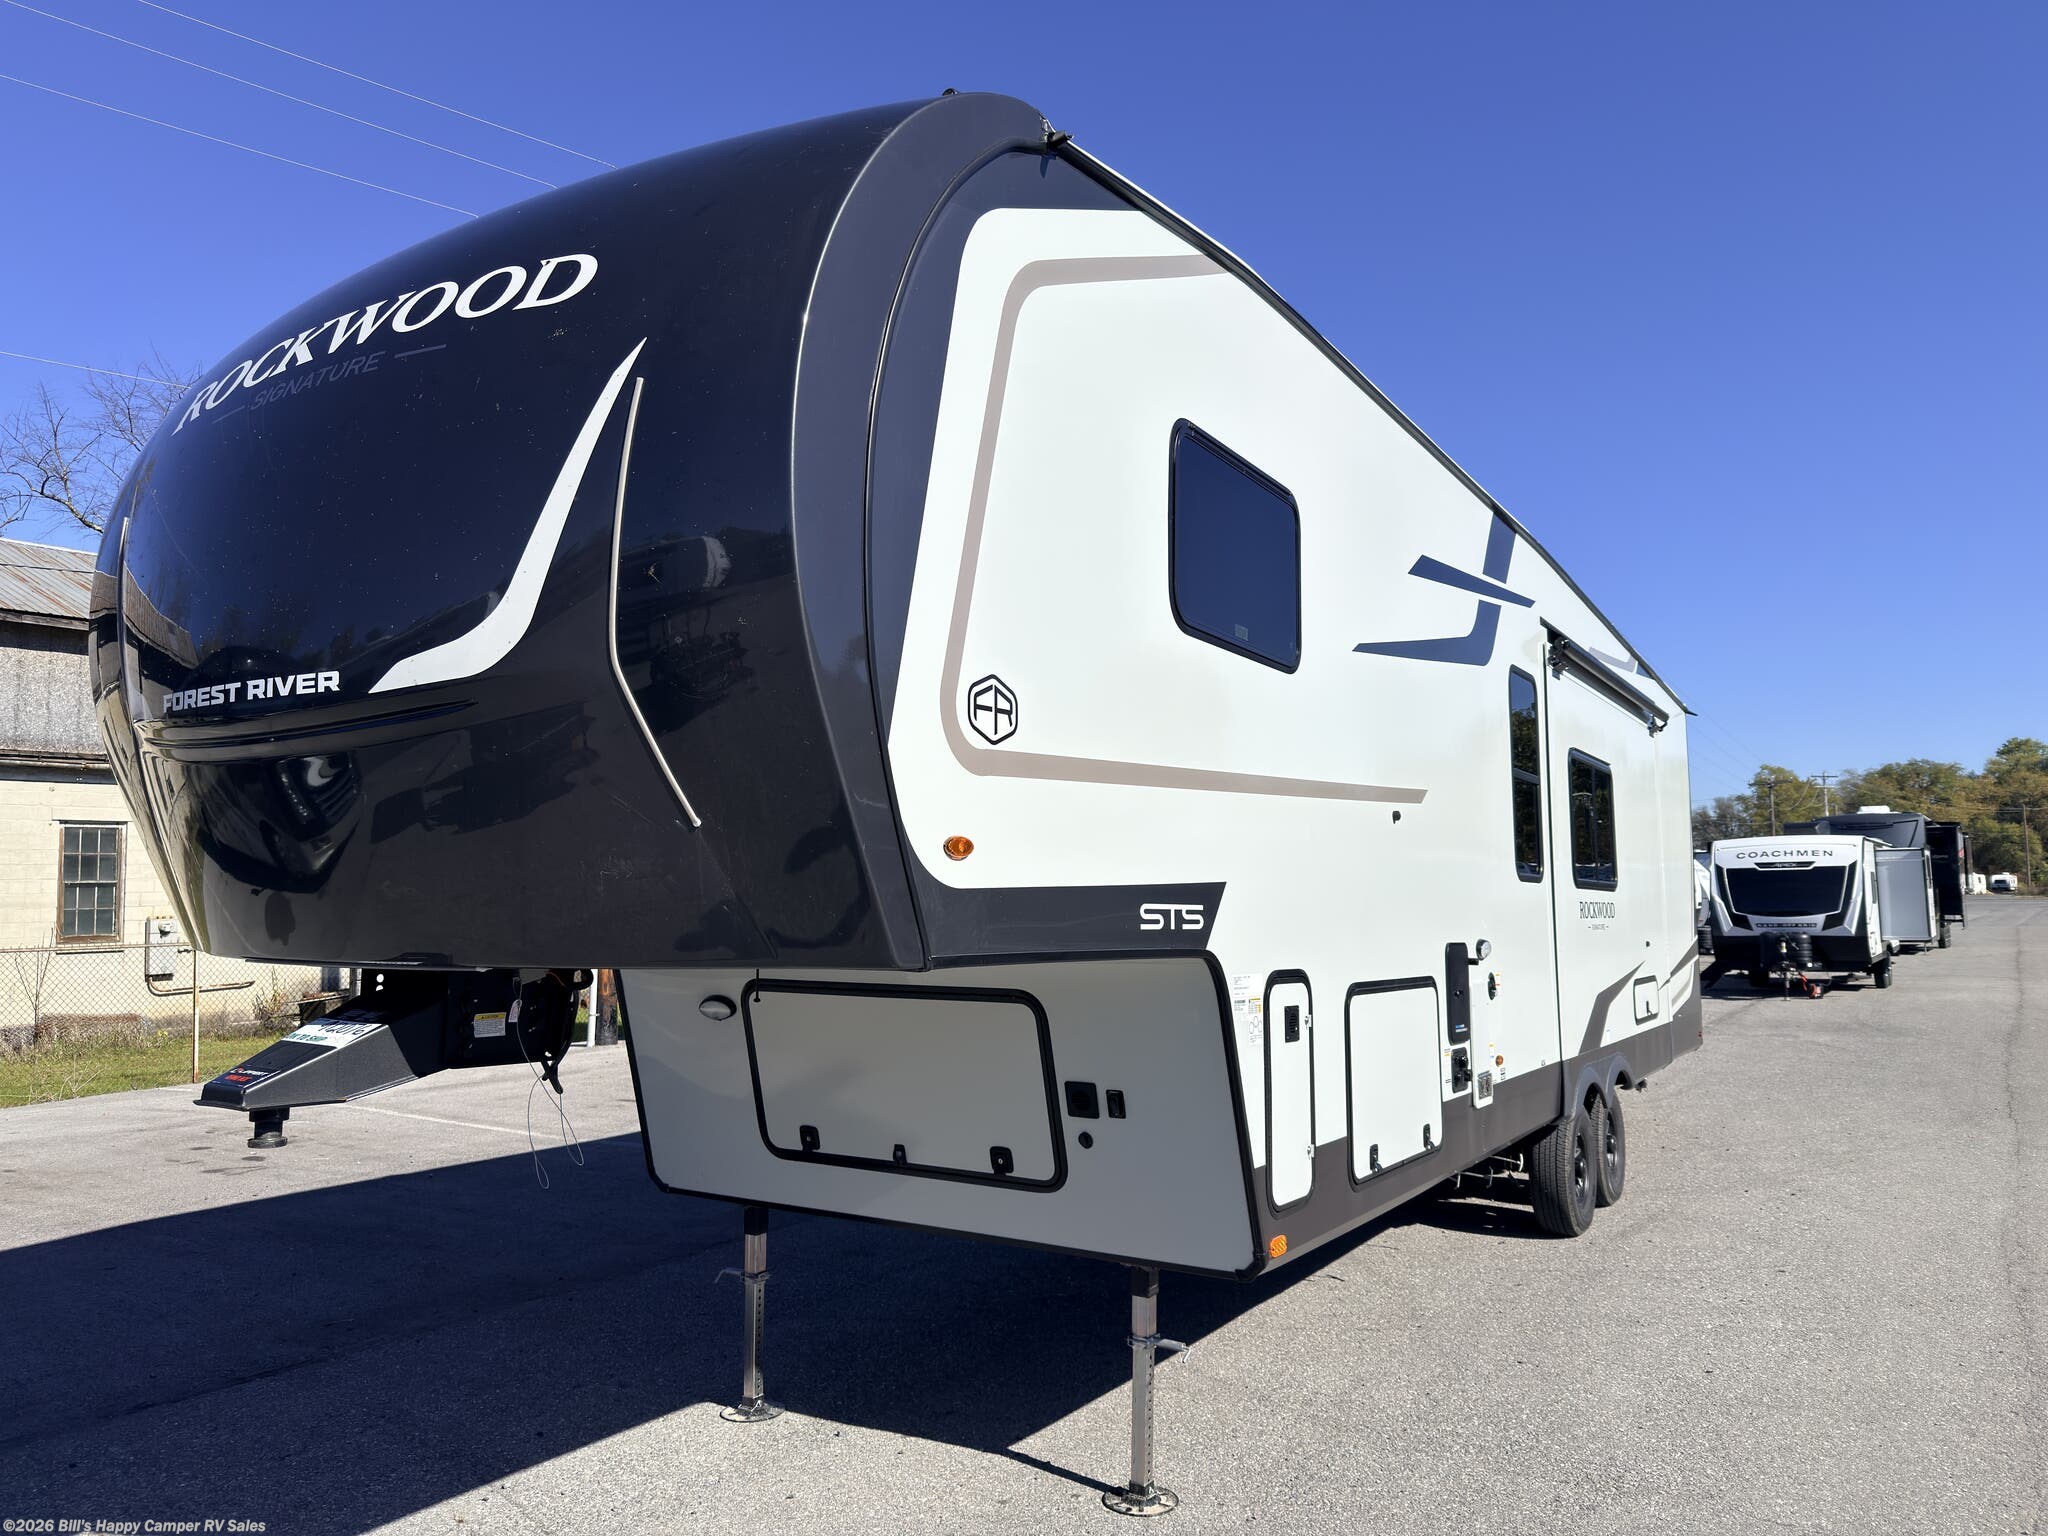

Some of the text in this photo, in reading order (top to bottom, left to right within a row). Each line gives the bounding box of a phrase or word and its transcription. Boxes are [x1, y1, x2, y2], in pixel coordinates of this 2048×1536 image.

[172, 253, 598, 435] ROCKWOOD
[250, 351, 386, 411] SIGNATURE
[163, 670, 340, 716] FOREST RIVER
[1736, 849, 1833, 860] COACHMEN
[1139, 902, 1205, 930] STS
[1579, 901, 1616, 919] ROCKWOOD
